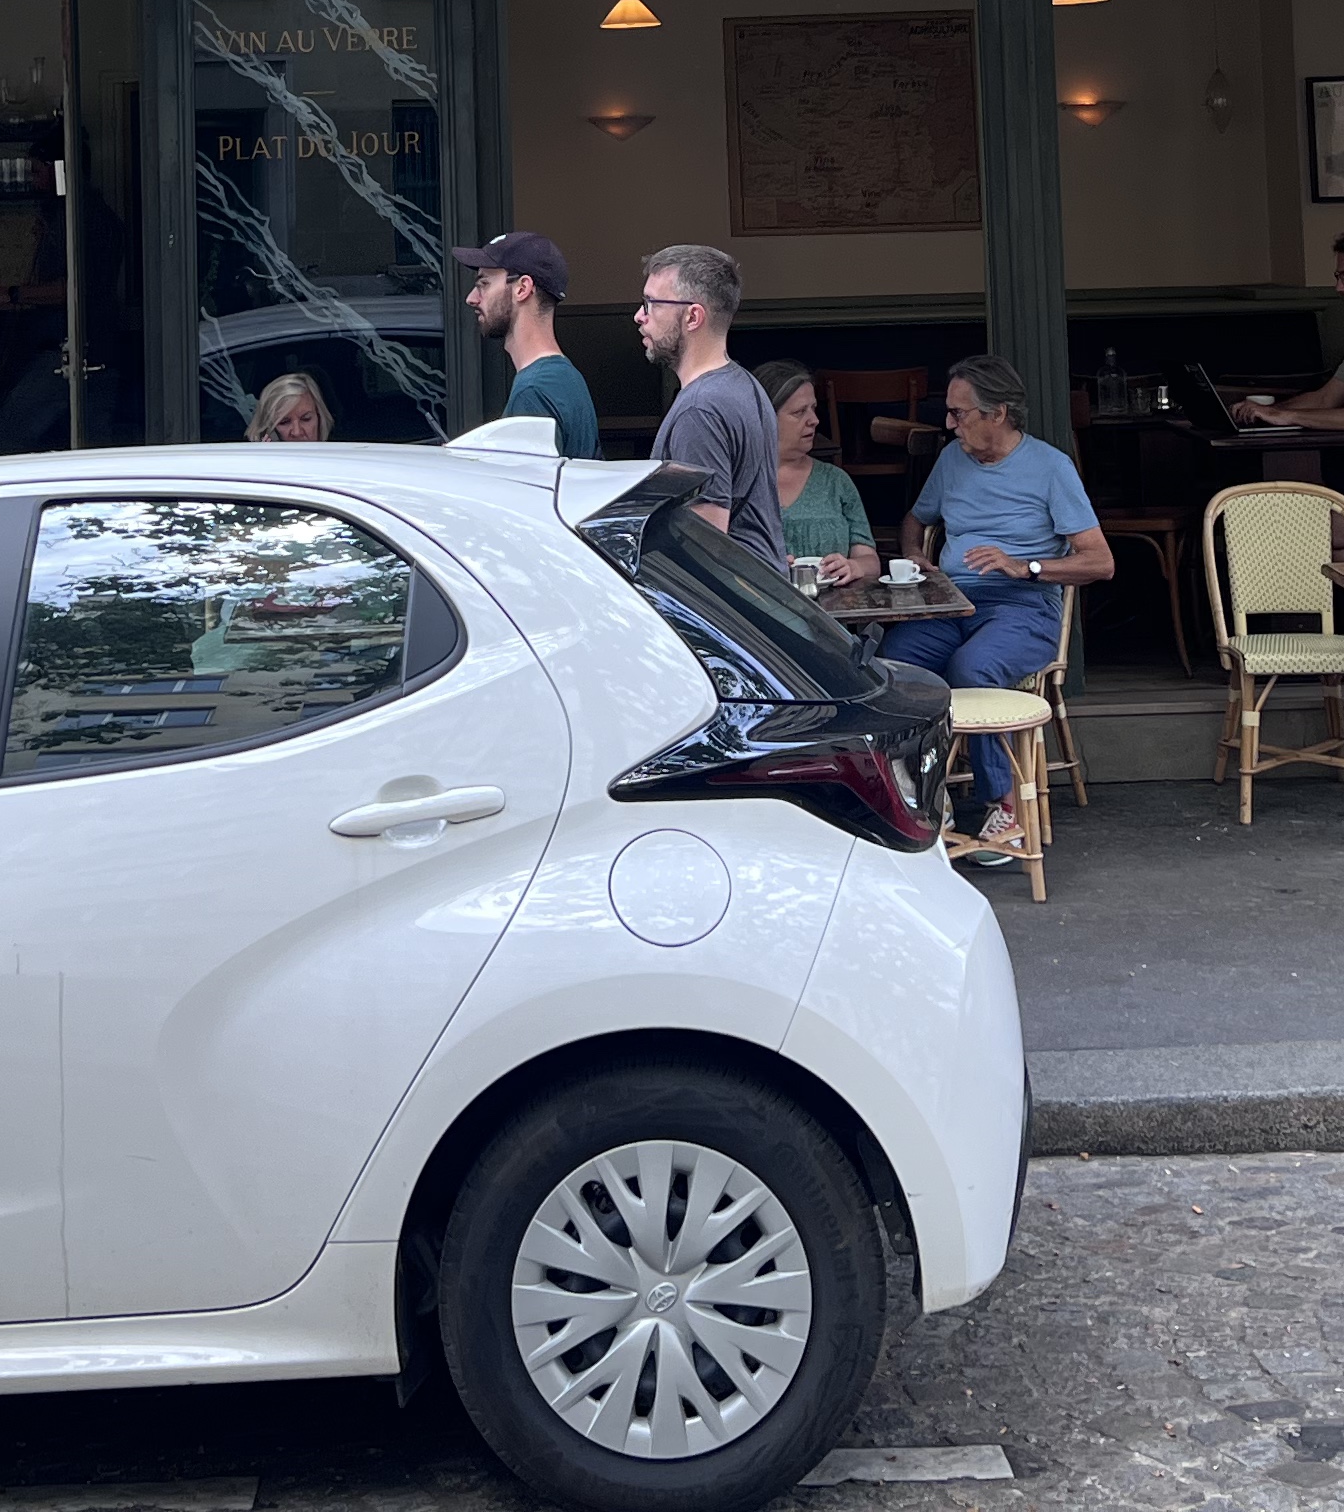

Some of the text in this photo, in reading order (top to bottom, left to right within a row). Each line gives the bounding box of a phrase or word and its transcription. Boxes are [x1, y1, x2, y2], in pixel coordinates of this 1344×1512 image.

[215, 29, 267, 55] VIN
[275, 29, 316, 54] AU
[218, 135, 289, 161] PLAT
[346, 130, 422, 157] JOUR
